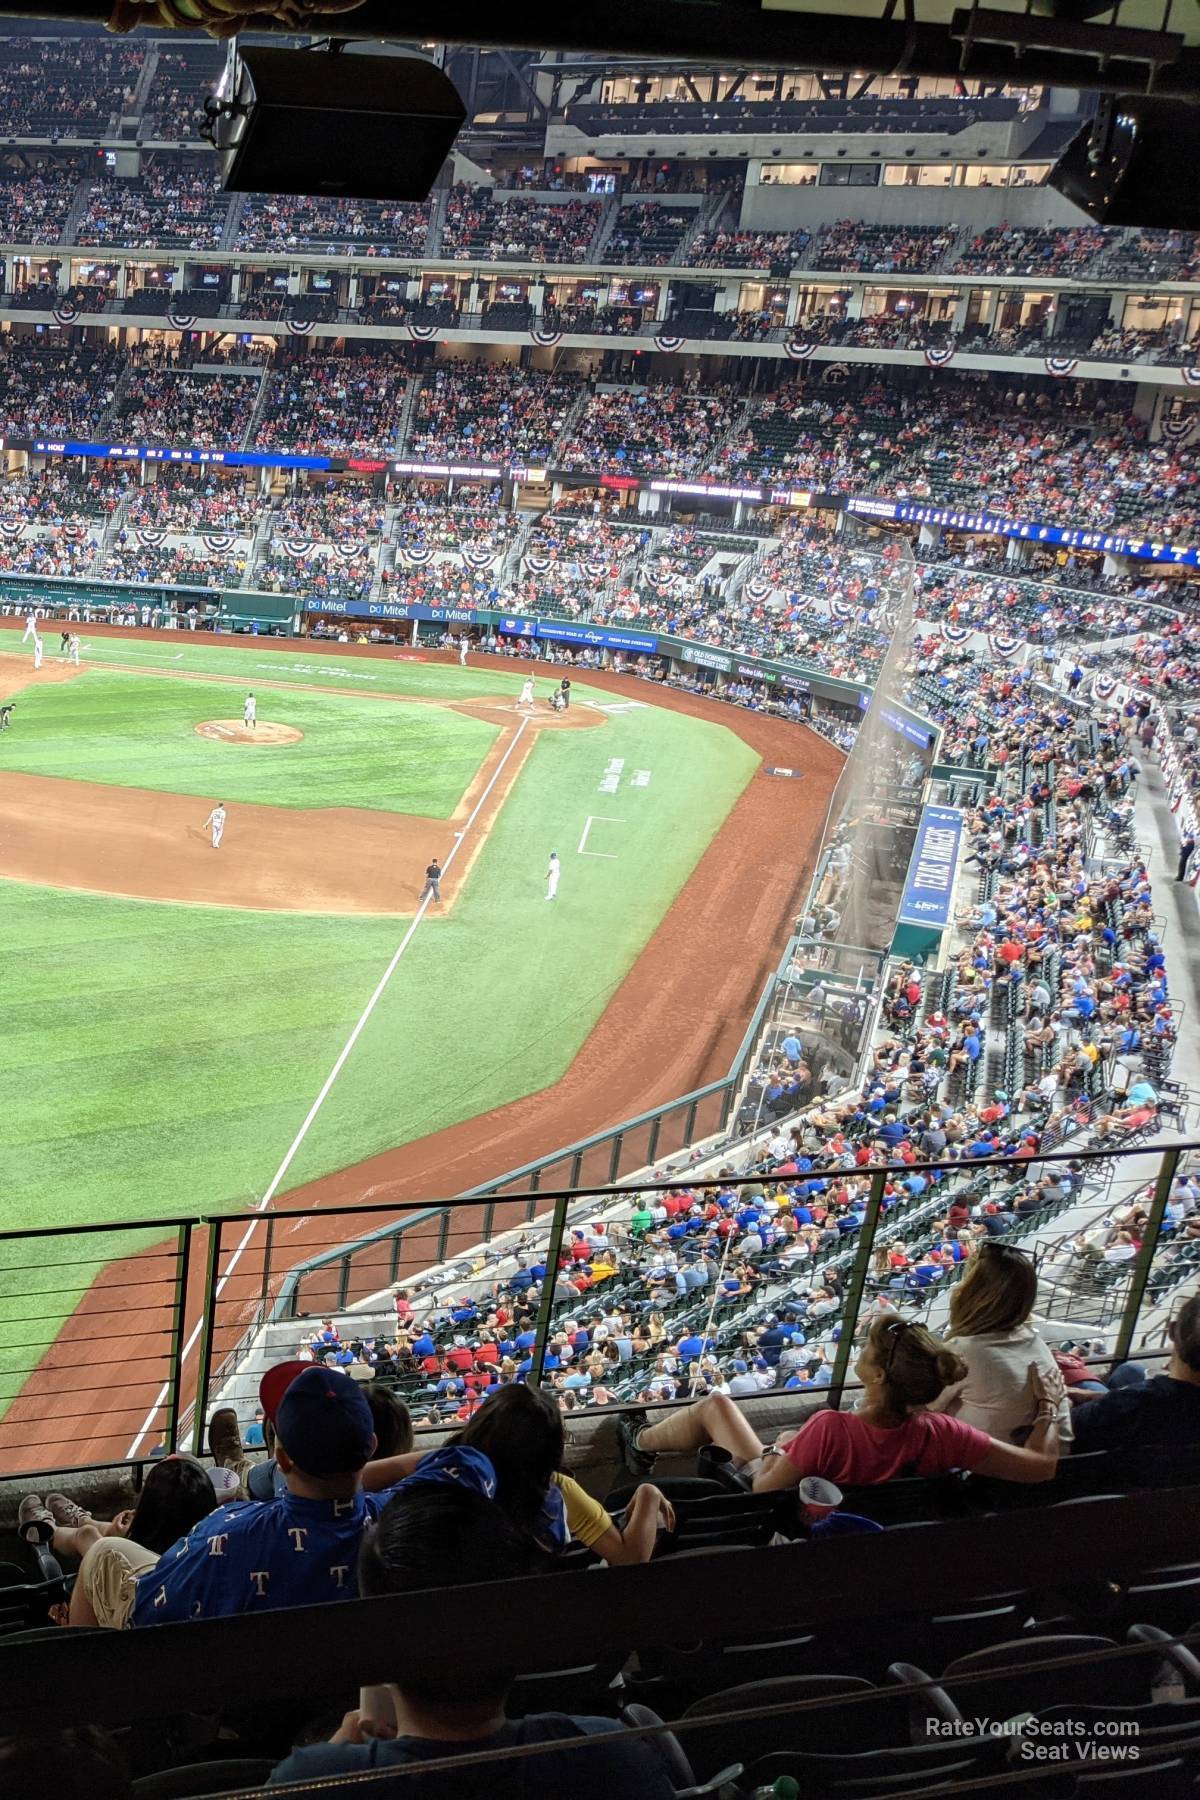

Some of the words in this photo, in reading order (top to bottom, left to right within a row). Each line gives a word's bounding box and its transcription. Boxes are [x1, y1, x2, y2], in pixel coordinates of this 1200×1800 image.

[321, 601, 348, 612] Mitel
[383, 605, 408, 616] Mitel
[445, 610, 472, 621] Mitel
[694, 650, 704, 658] OLD
[738, 666, 753, 676] Globe
[754, 670, 764, 678] Life
[764, 672, 776, 682] Field
[920, 826, 956, 862] RANGERS
[914, 861, 951, 891] TEXAS
[288, 1528, 307, 1552] T
[250, 1572, 270, 1596] T
[330, 1566, 349, 1588] T
